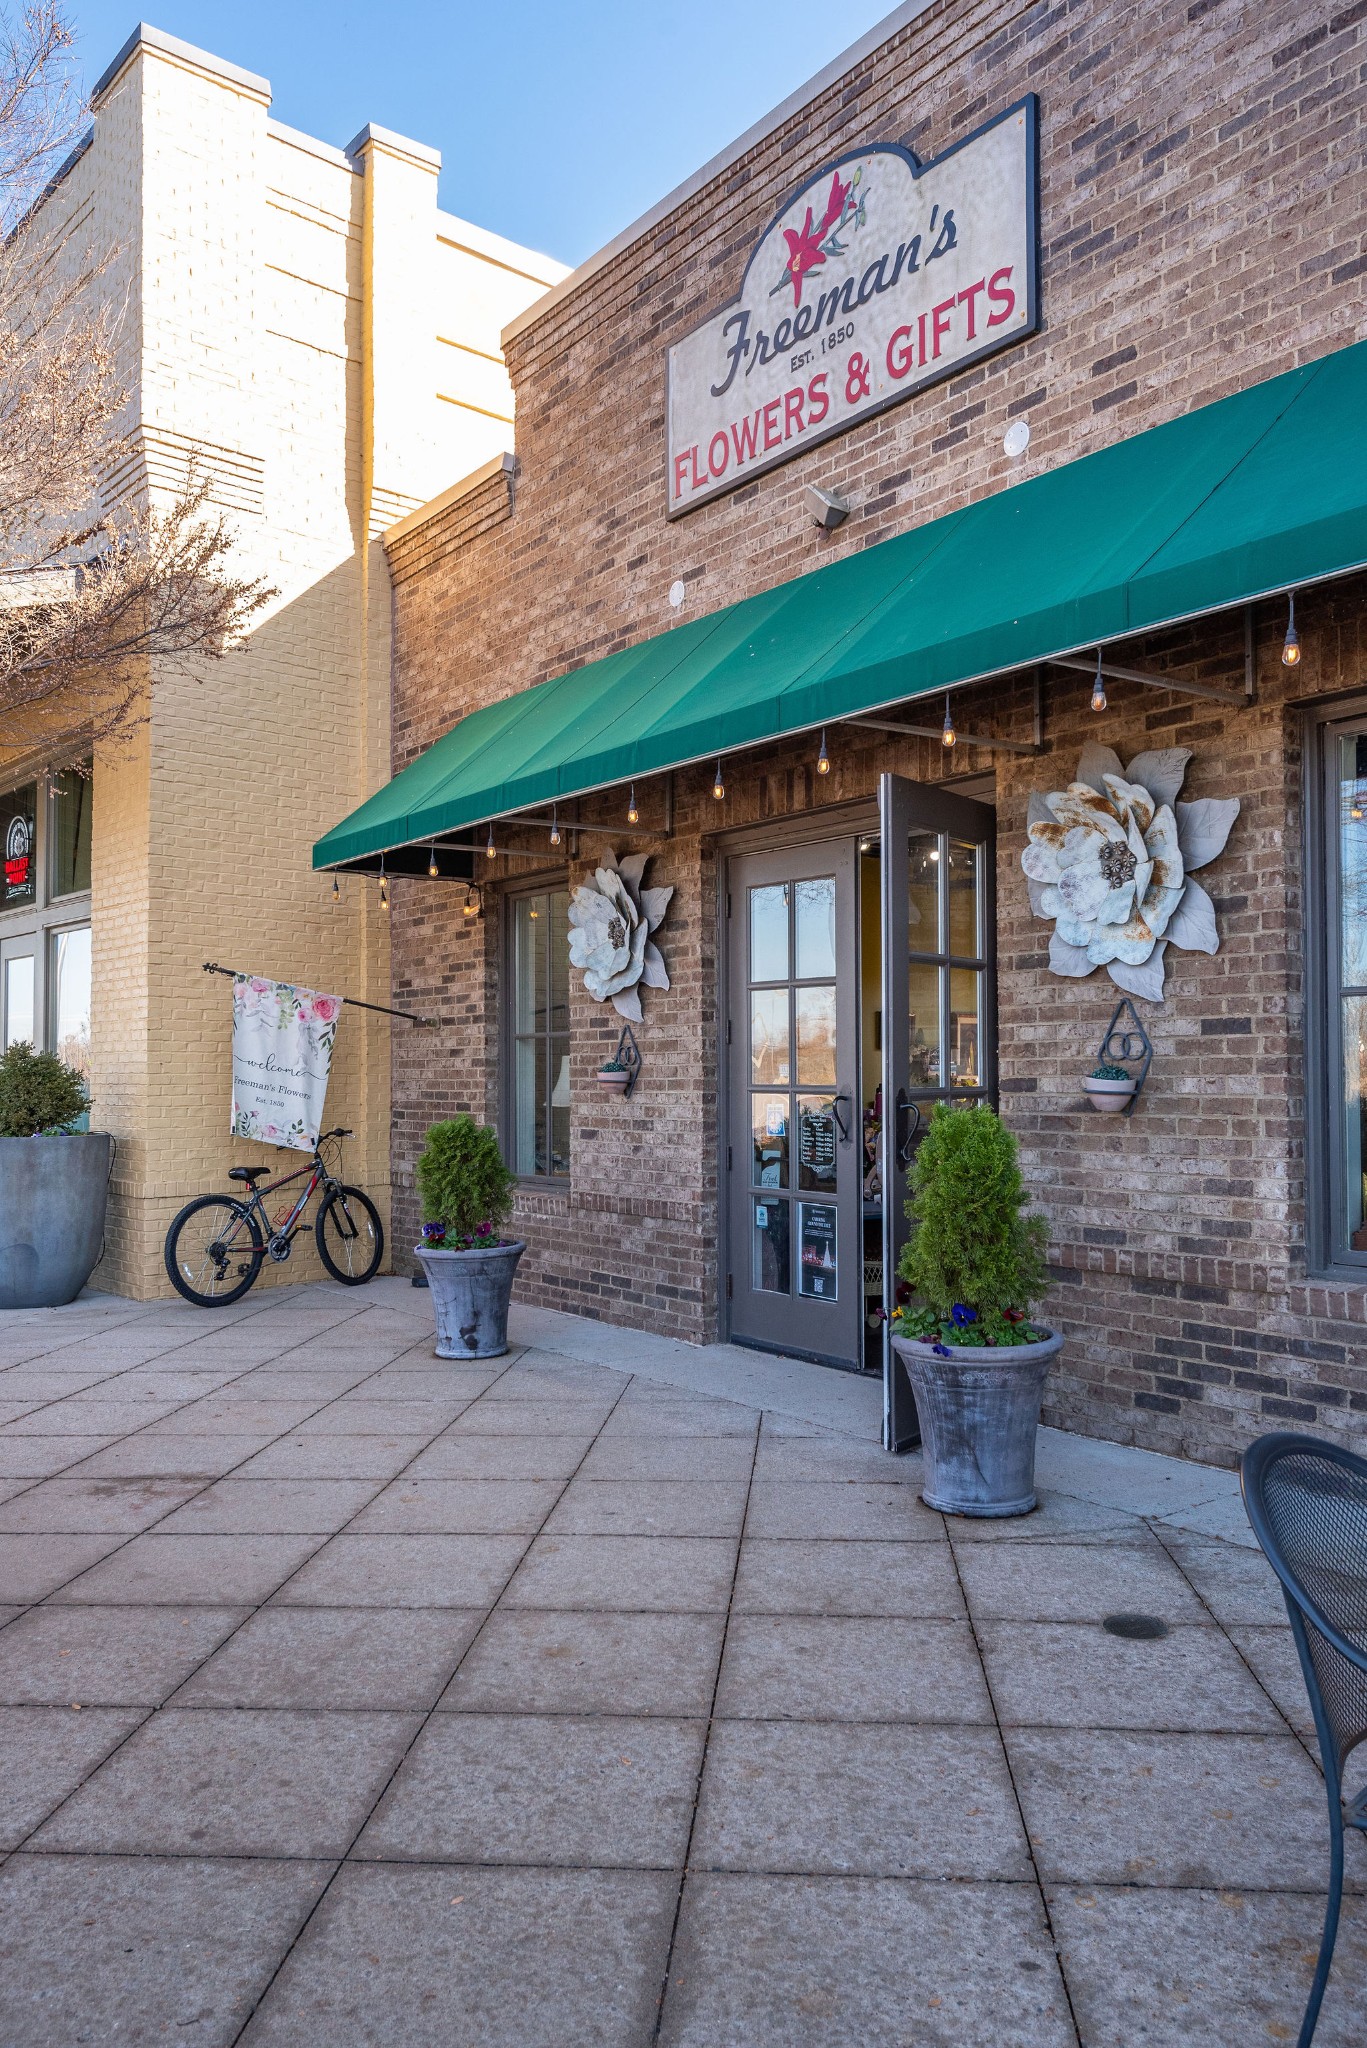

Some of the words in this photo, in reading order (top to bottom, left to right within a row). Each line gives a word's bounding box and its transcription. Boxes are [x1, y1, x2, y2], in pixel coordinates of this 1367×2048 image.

[711, 204, 958, 397] Freeman's
[790, 348, 816, 374] EST.
[820, 321, 855, 356] 1850
[674, 372, 829, 500] FLOWERS
[845, 351, 871, 404] &
[886, 265, 1017, 380] GIFTS
[234, 1053, 327, 1080] welcome
[234, 1075, 276, 1092] Freeman's
[278, 1085, 311, 1100] Flowers
[255, 1096, 267, 1104] Est.
[269, 1099, 285, 1107] 1850
